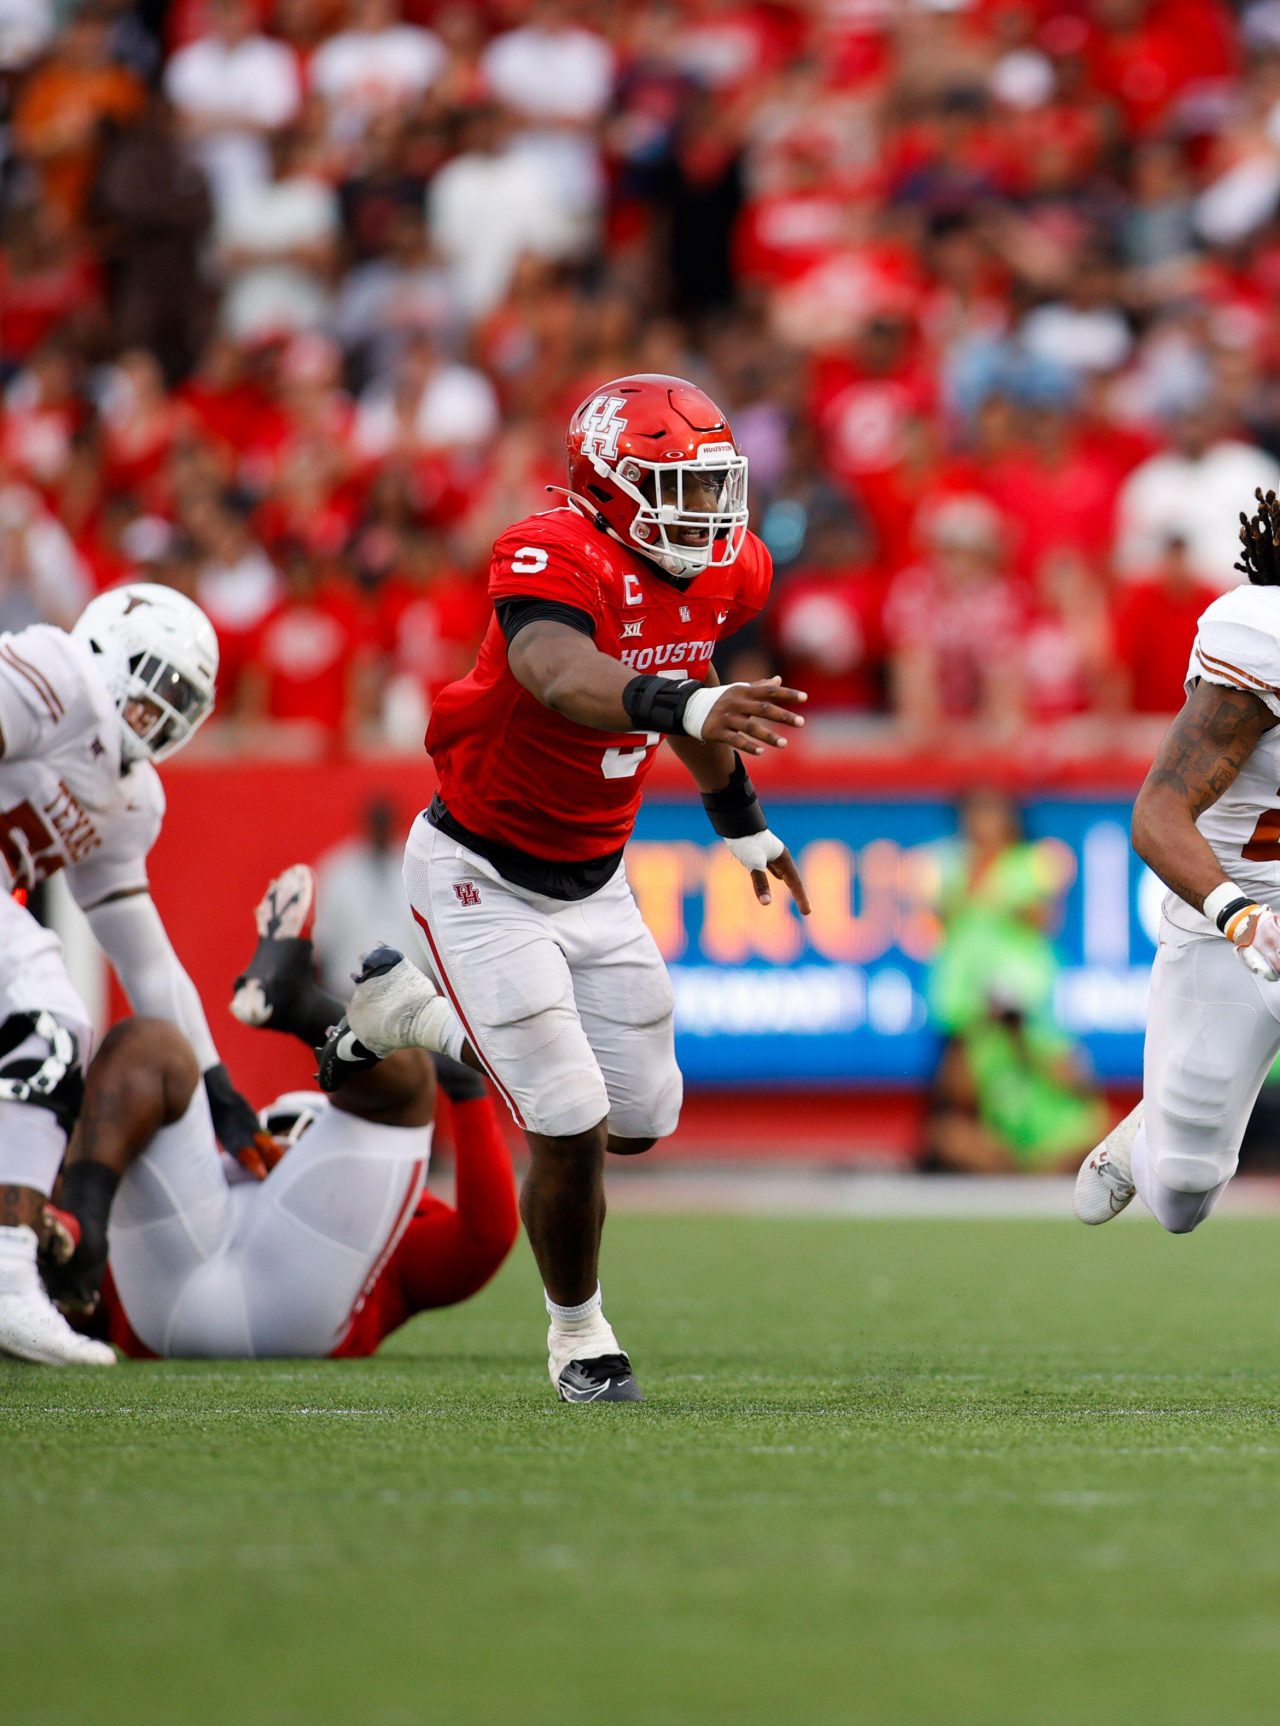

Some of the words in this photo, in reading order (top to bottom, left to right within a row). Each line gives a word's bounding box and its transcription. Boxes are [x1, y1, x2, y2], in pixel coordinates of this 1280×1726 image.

[624, 575, 643, 606] C
[619, 641, 715, 670] HOUSTO
[44, 779, 102, 863] TEXAS
